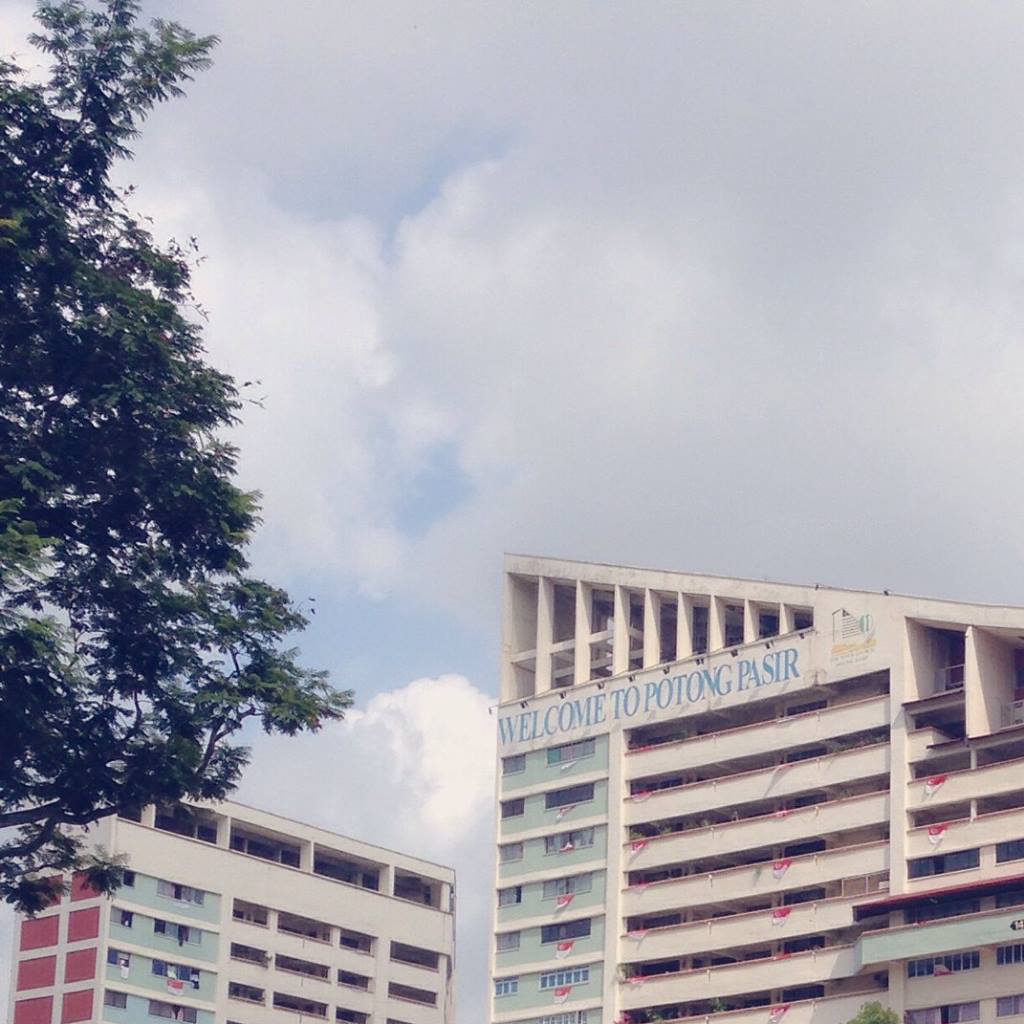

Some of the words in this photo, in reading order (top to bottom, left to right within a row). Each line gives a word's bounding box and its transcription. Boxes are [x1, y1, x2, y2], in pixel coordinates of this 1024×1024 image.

[498, 693, 606, 745] WELCOME
[611, 685, 640, 719] TO
[645, 664, 733, 712] POTONG
[737, 648, 800, 692] PASIR
